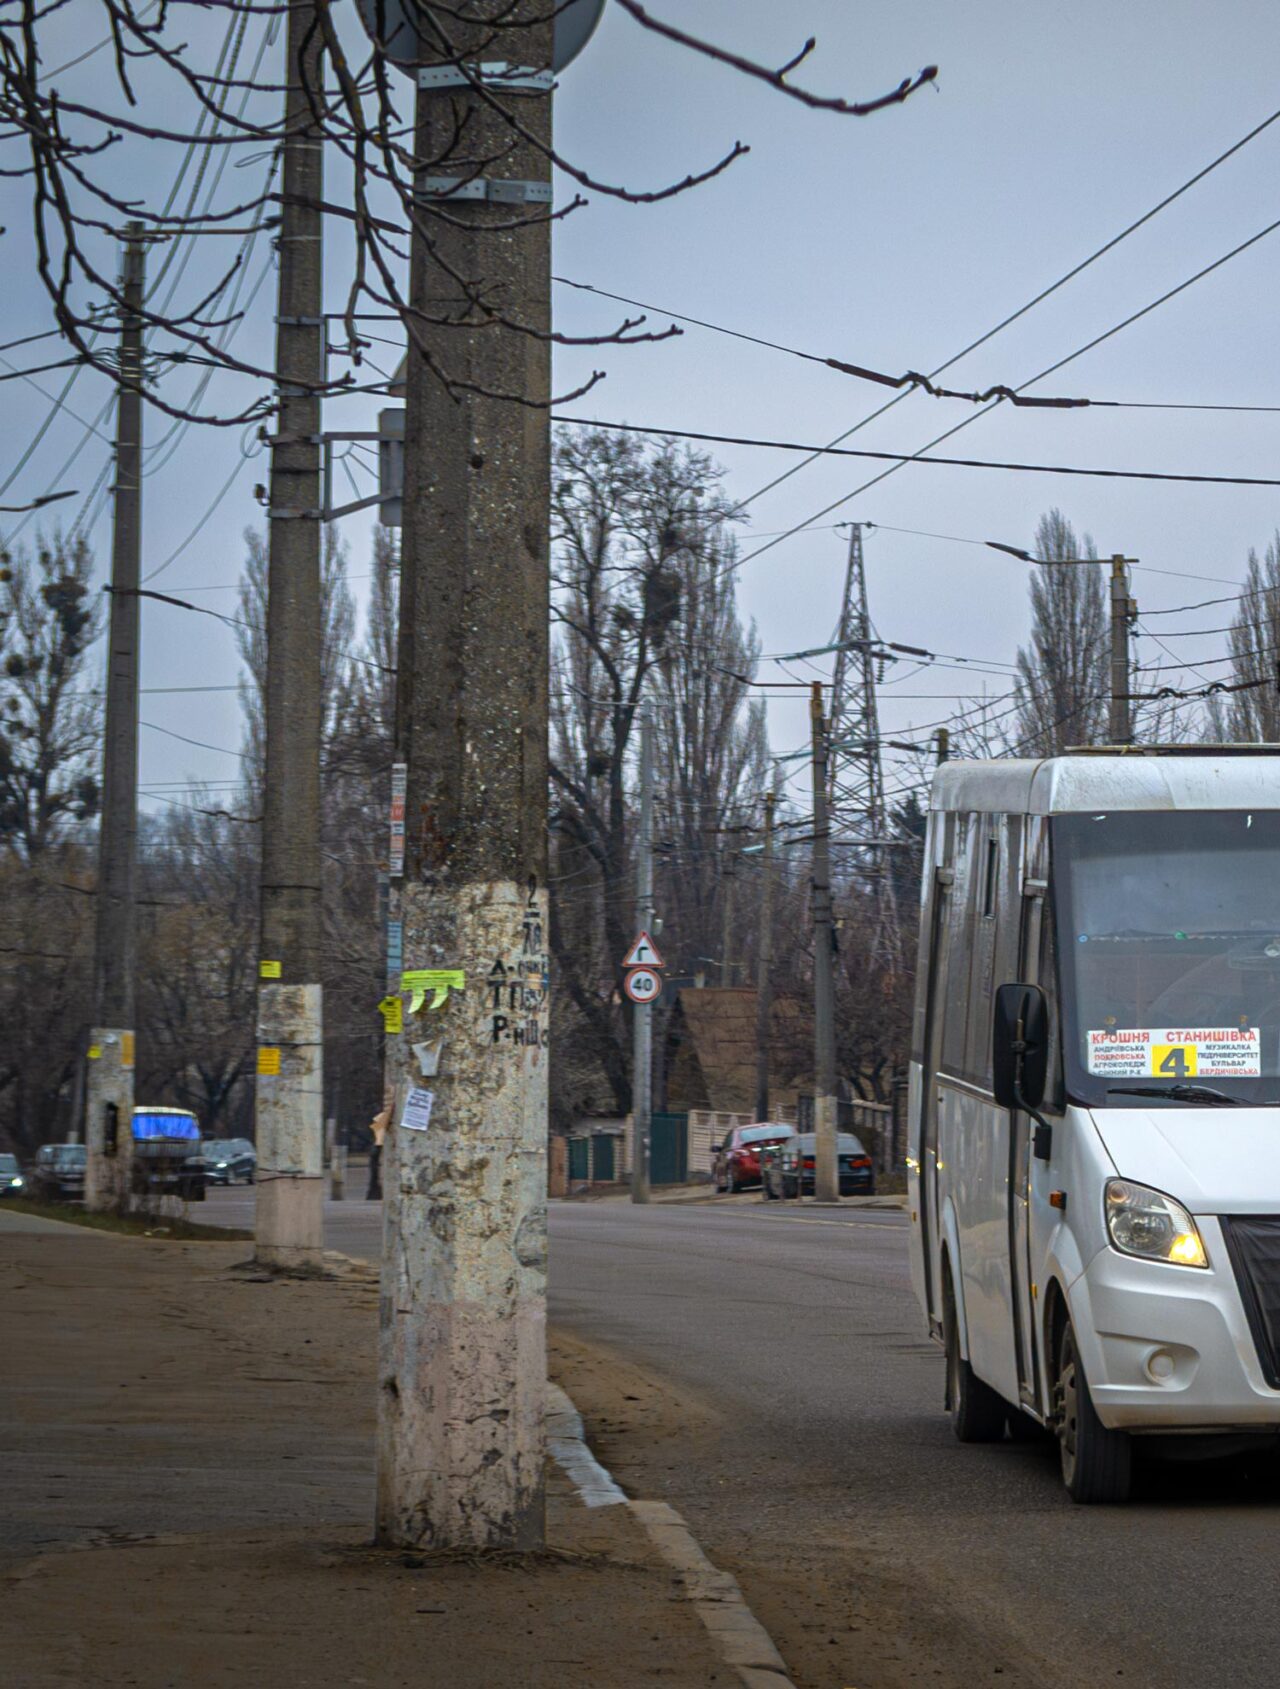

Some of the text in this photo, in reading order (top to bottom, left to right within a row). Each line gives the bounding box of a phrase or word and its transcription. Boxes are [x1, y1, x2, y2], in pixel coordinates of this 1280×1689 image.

[632, 978, 653, 991] 40
[1092, 1030, 1257, 1044] КРОШНЯ СТАНИШІВКА
[1159, 1048, 1190, 1077] 4
